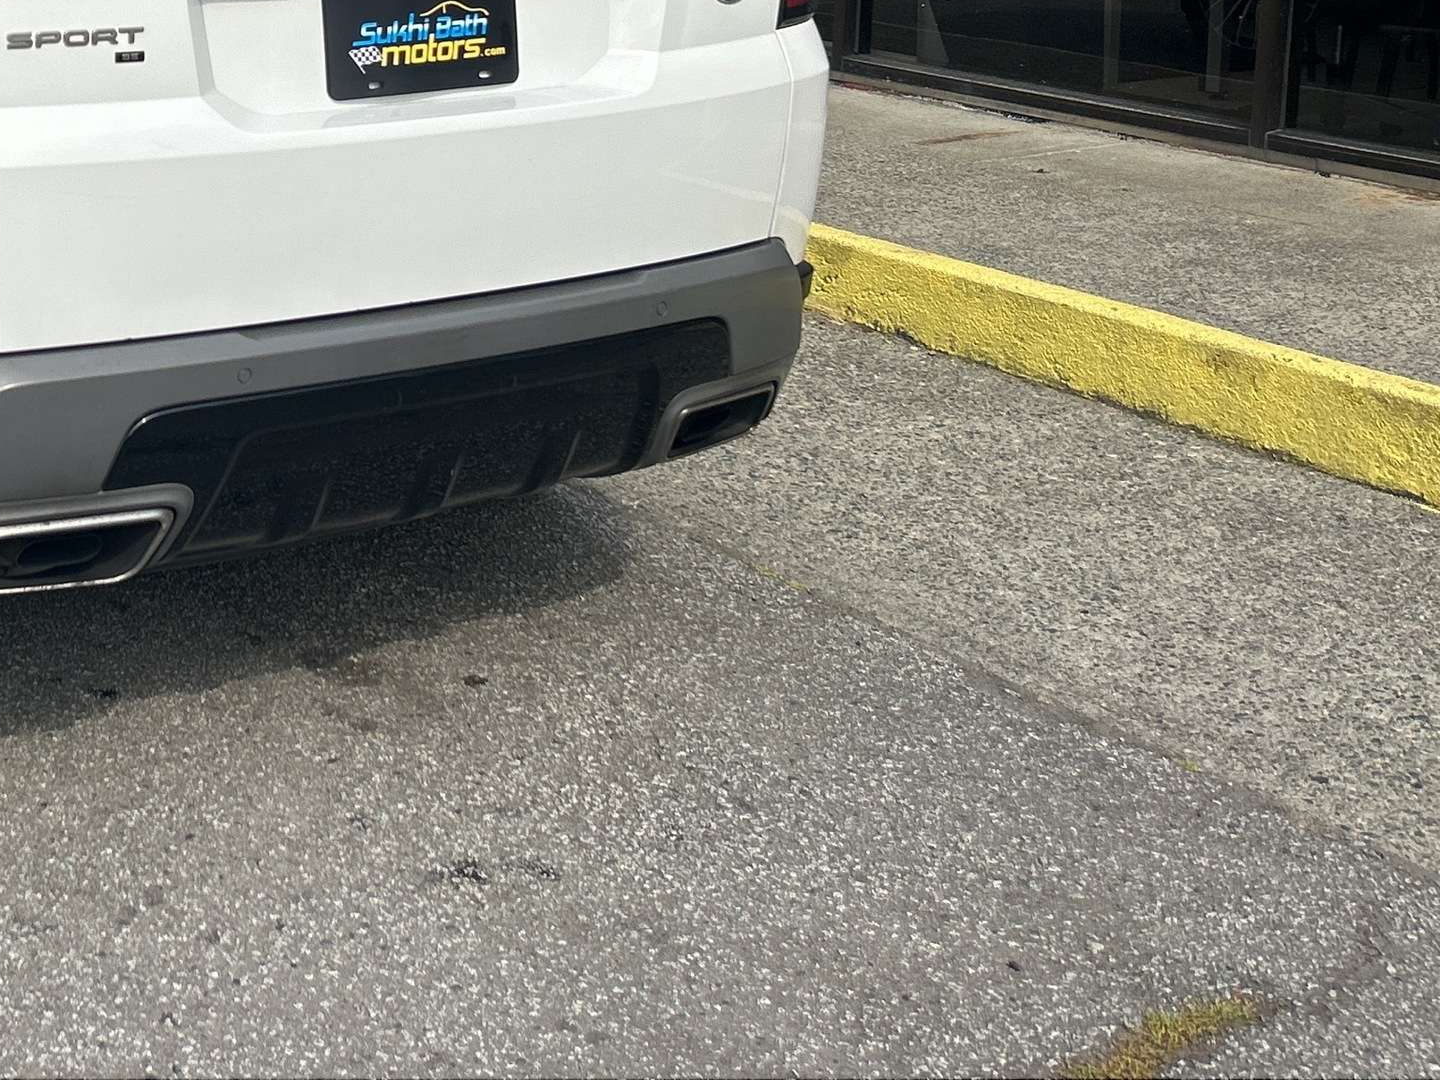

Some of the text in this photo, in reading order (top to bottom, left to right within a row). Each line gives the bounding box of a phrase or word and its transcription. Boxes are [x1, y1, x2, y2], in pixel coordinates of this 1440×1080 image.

[6, 26, 145, 50] SPORT
[352, 13, 488, 47] Sukhi Bath
